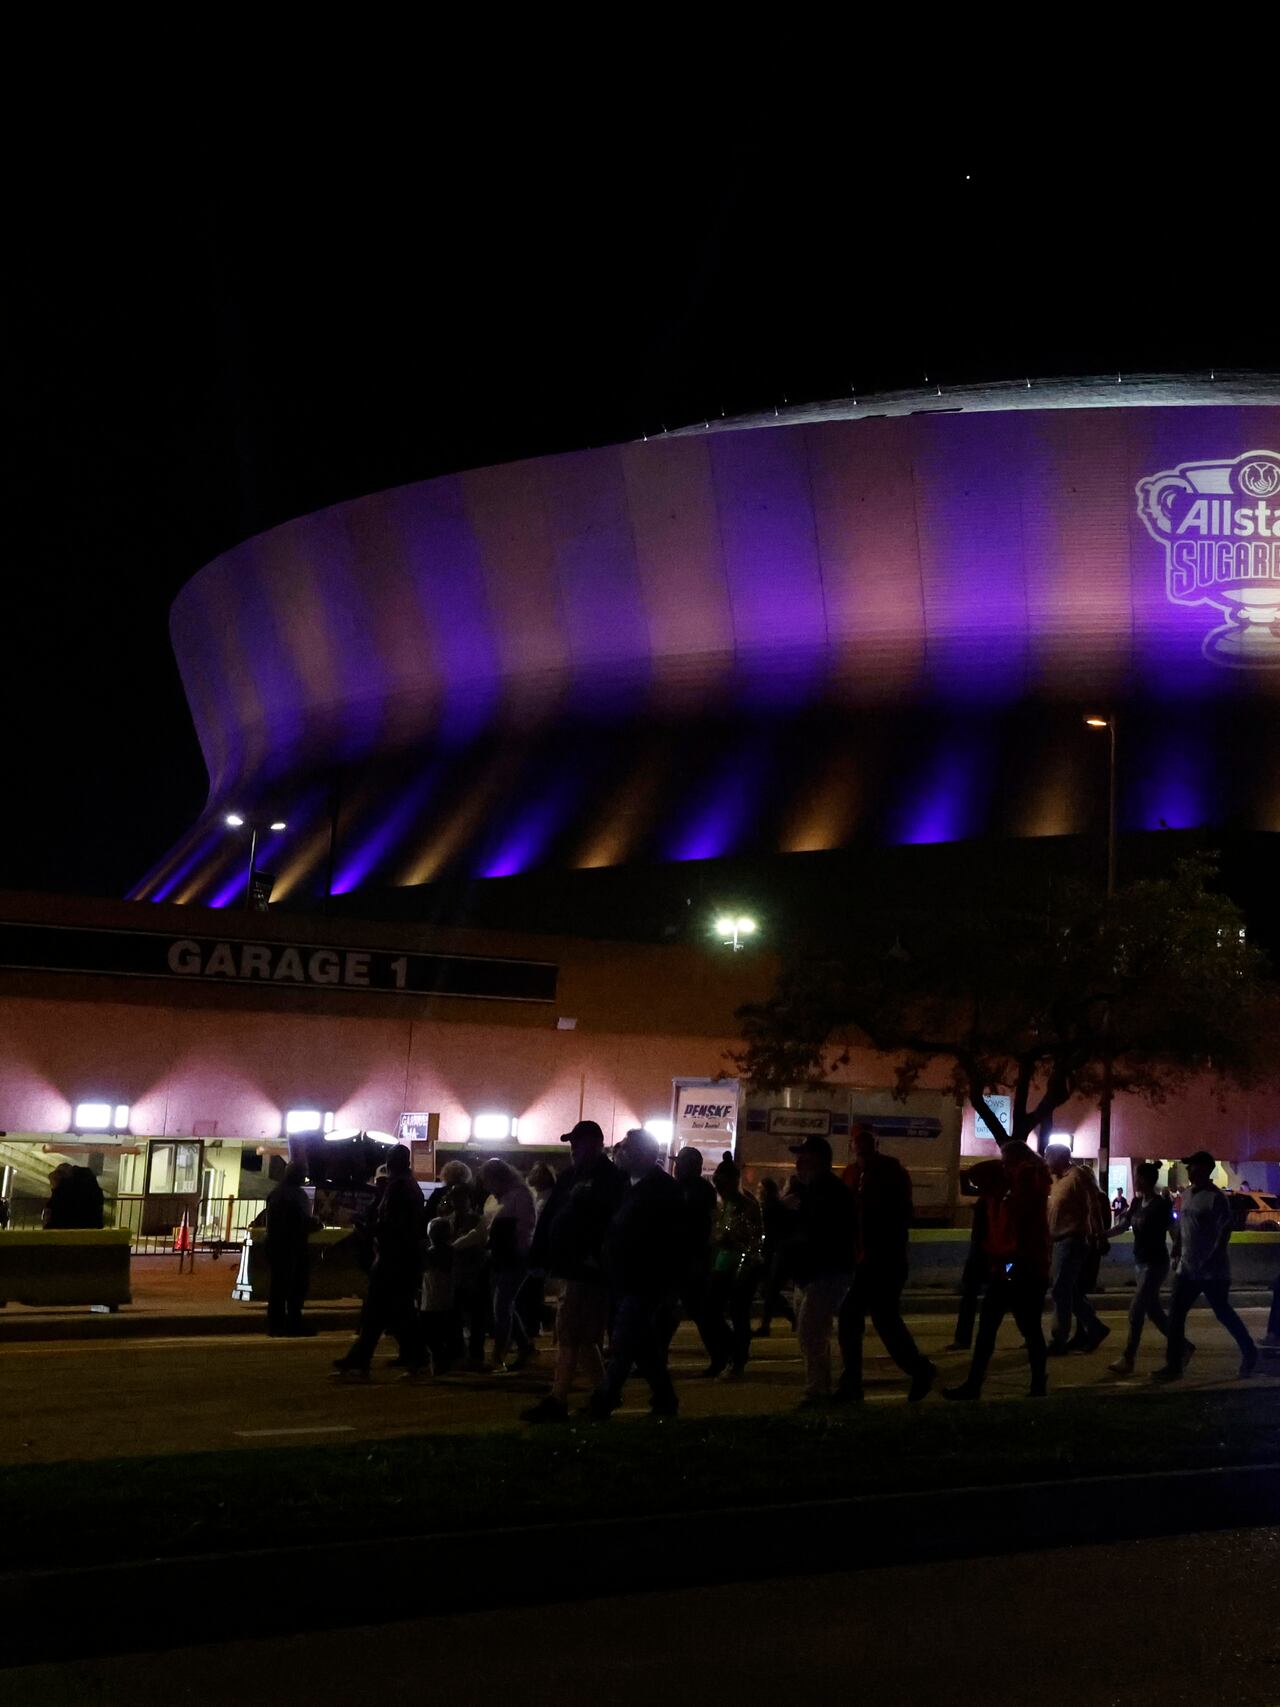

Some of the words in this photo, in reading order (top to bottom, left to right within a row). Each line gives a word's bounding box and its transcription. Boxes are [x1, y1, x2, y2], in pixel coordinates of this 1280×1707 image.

[167, 939, 372, 986] GARAGE
[390, 956, 408, 989] 1
[683, 1104, 733, 1118] PENSKE
